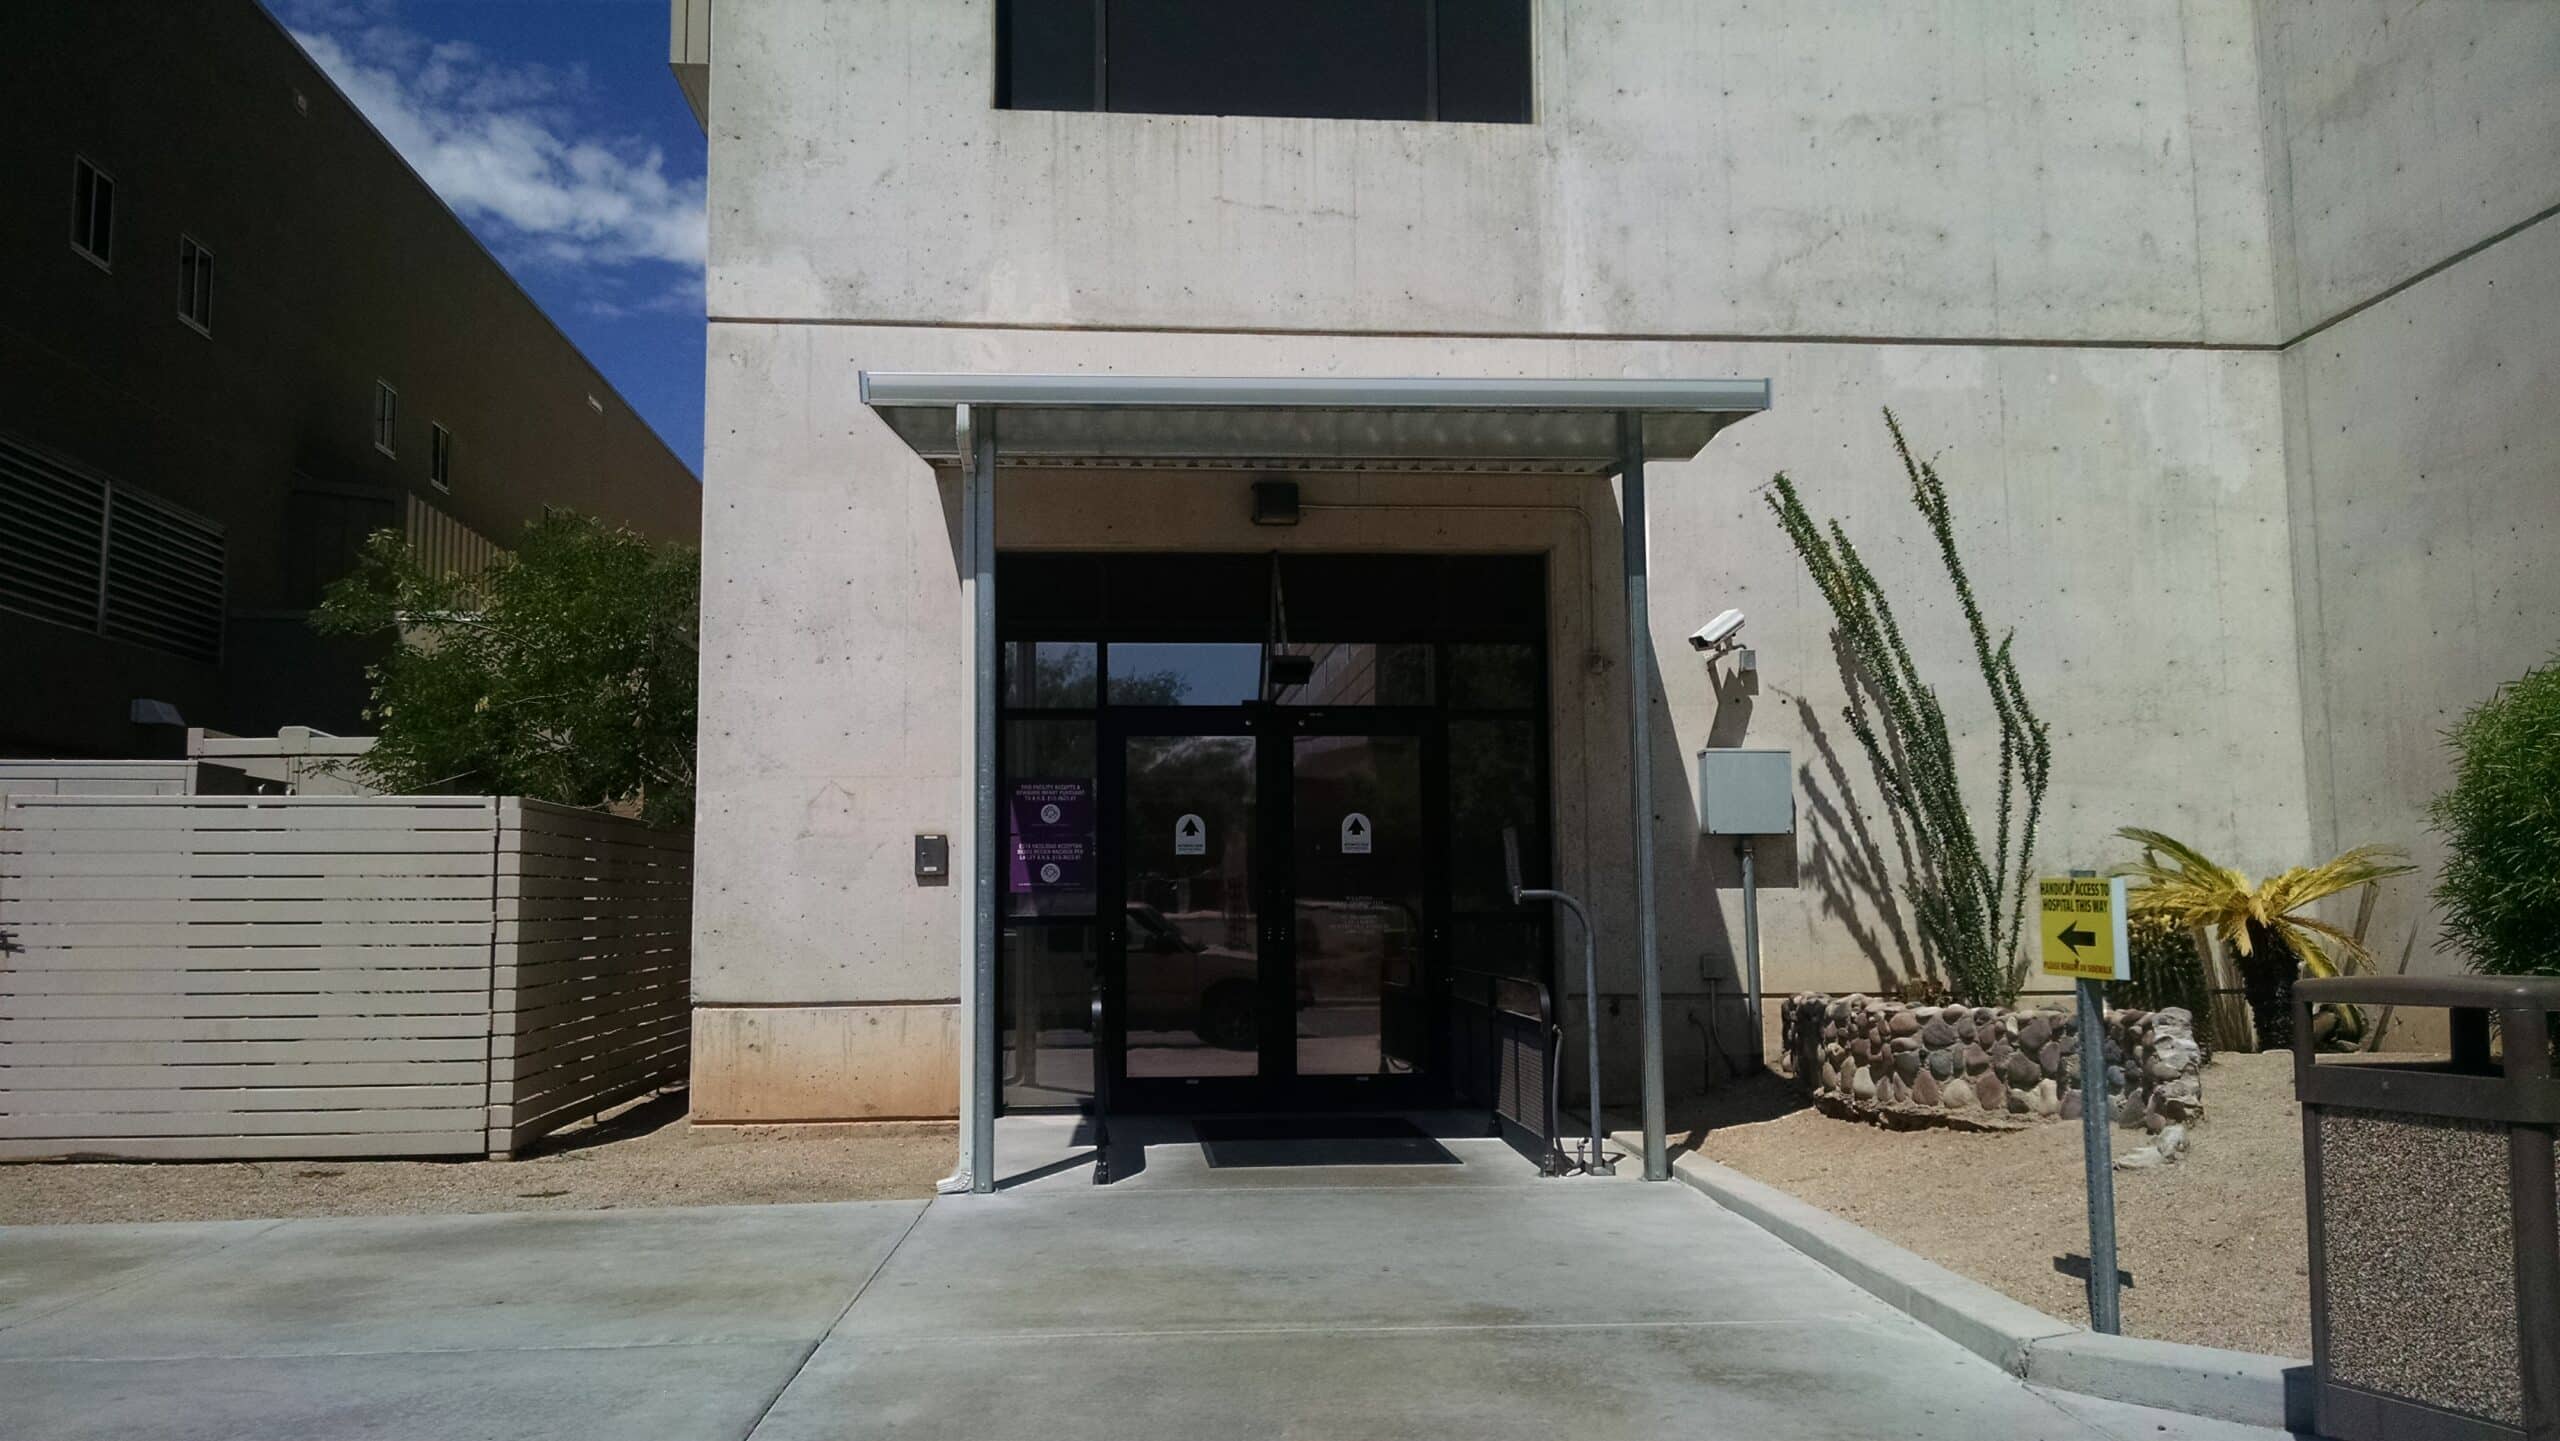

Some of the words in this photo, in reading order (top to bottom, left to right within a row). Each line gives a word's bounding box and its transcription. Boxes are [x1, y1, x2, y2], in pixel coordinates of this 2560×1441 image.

[2075, 883, 2100, 896] ACCESS
[2100, 883, 2110, 896] TO
[2042, 898, 2074, 912] HOSPITAL
[2075, 899, 2092, 912] THIS
[2092, 899, 2108, 912] WAY
